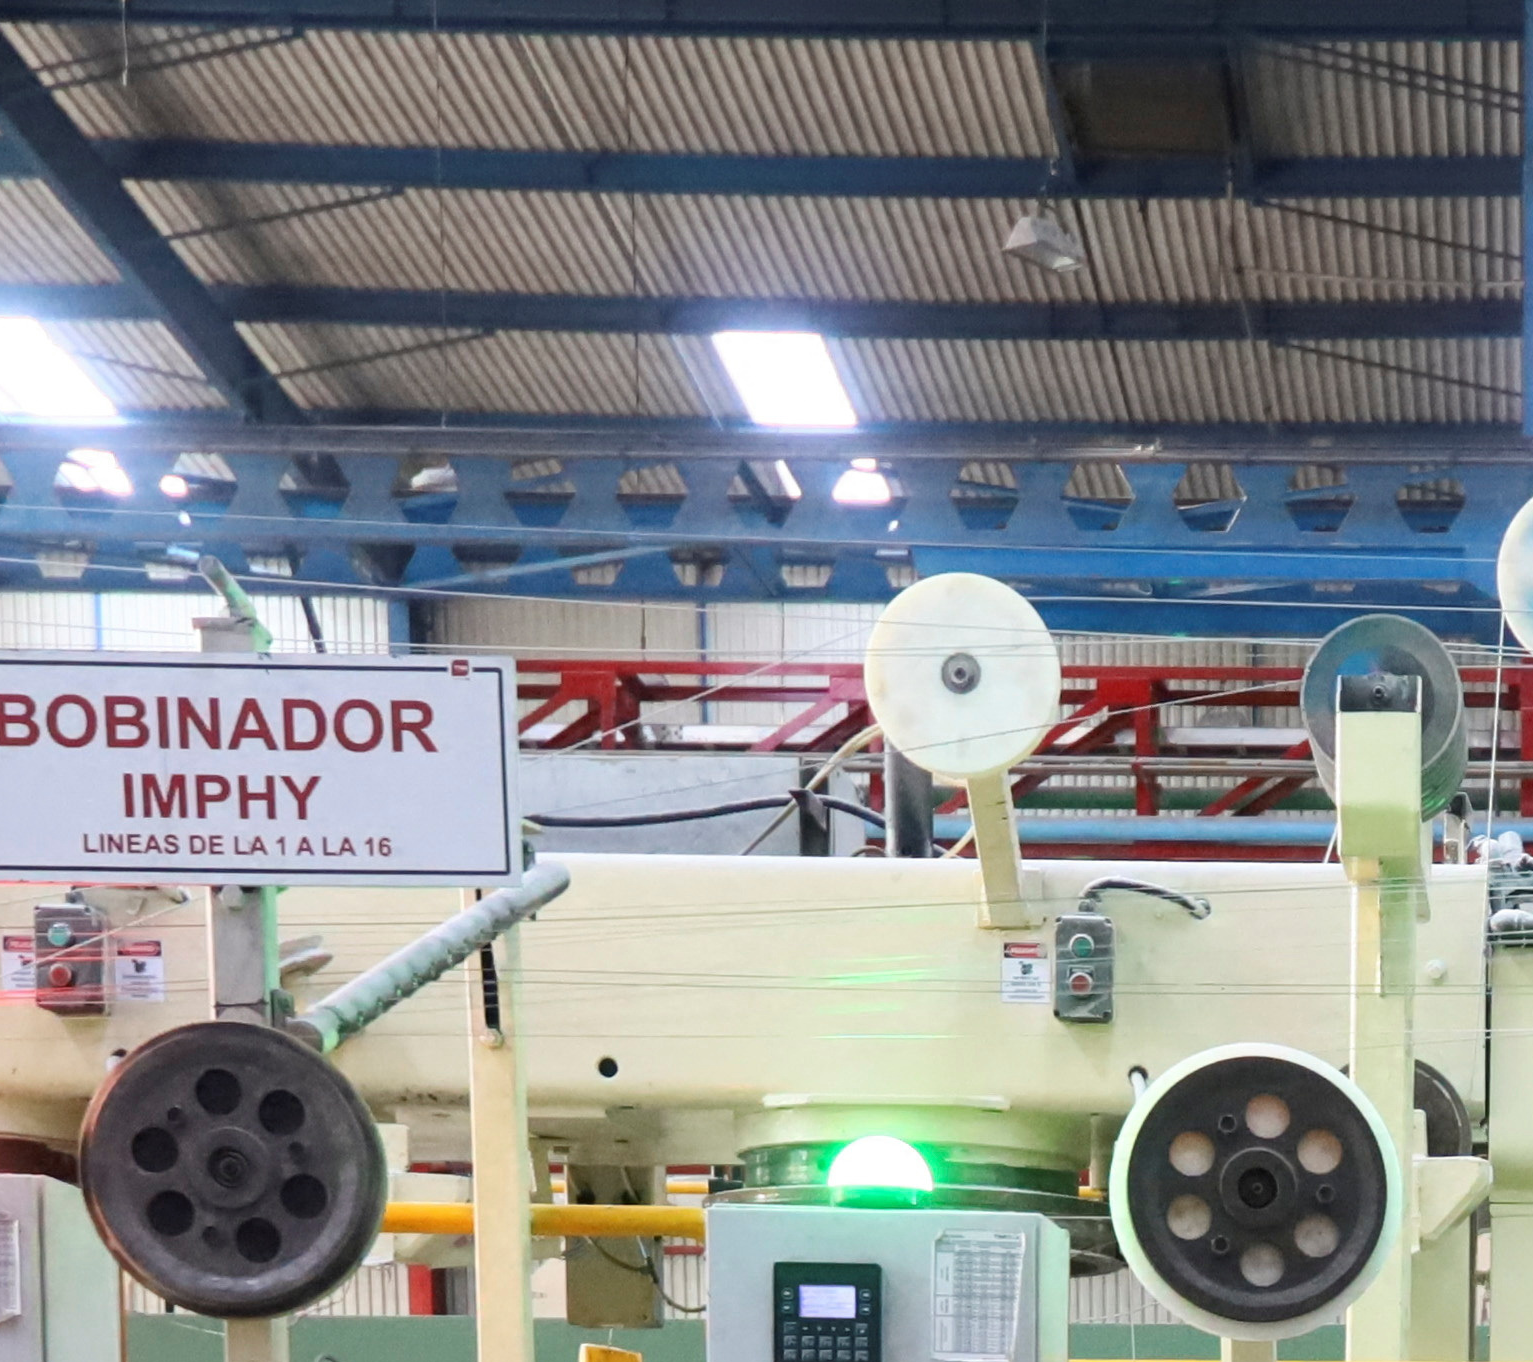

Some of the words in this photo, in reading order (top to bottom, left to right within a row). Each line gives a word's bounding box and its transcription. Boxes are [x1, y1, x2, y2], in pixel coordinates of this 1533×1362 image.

[123, 773, 321, 820] IMPHY
[83, 833, 179, 854] LINEAS
[189, 834, 224, 855] DE
[234, 836, 268, 856] LA
[276, 836, 287, 856] 1
[296, 837, 316, 857] A
[322, 837, 357, 857] LA
[364, 838, 393, 857] 16
